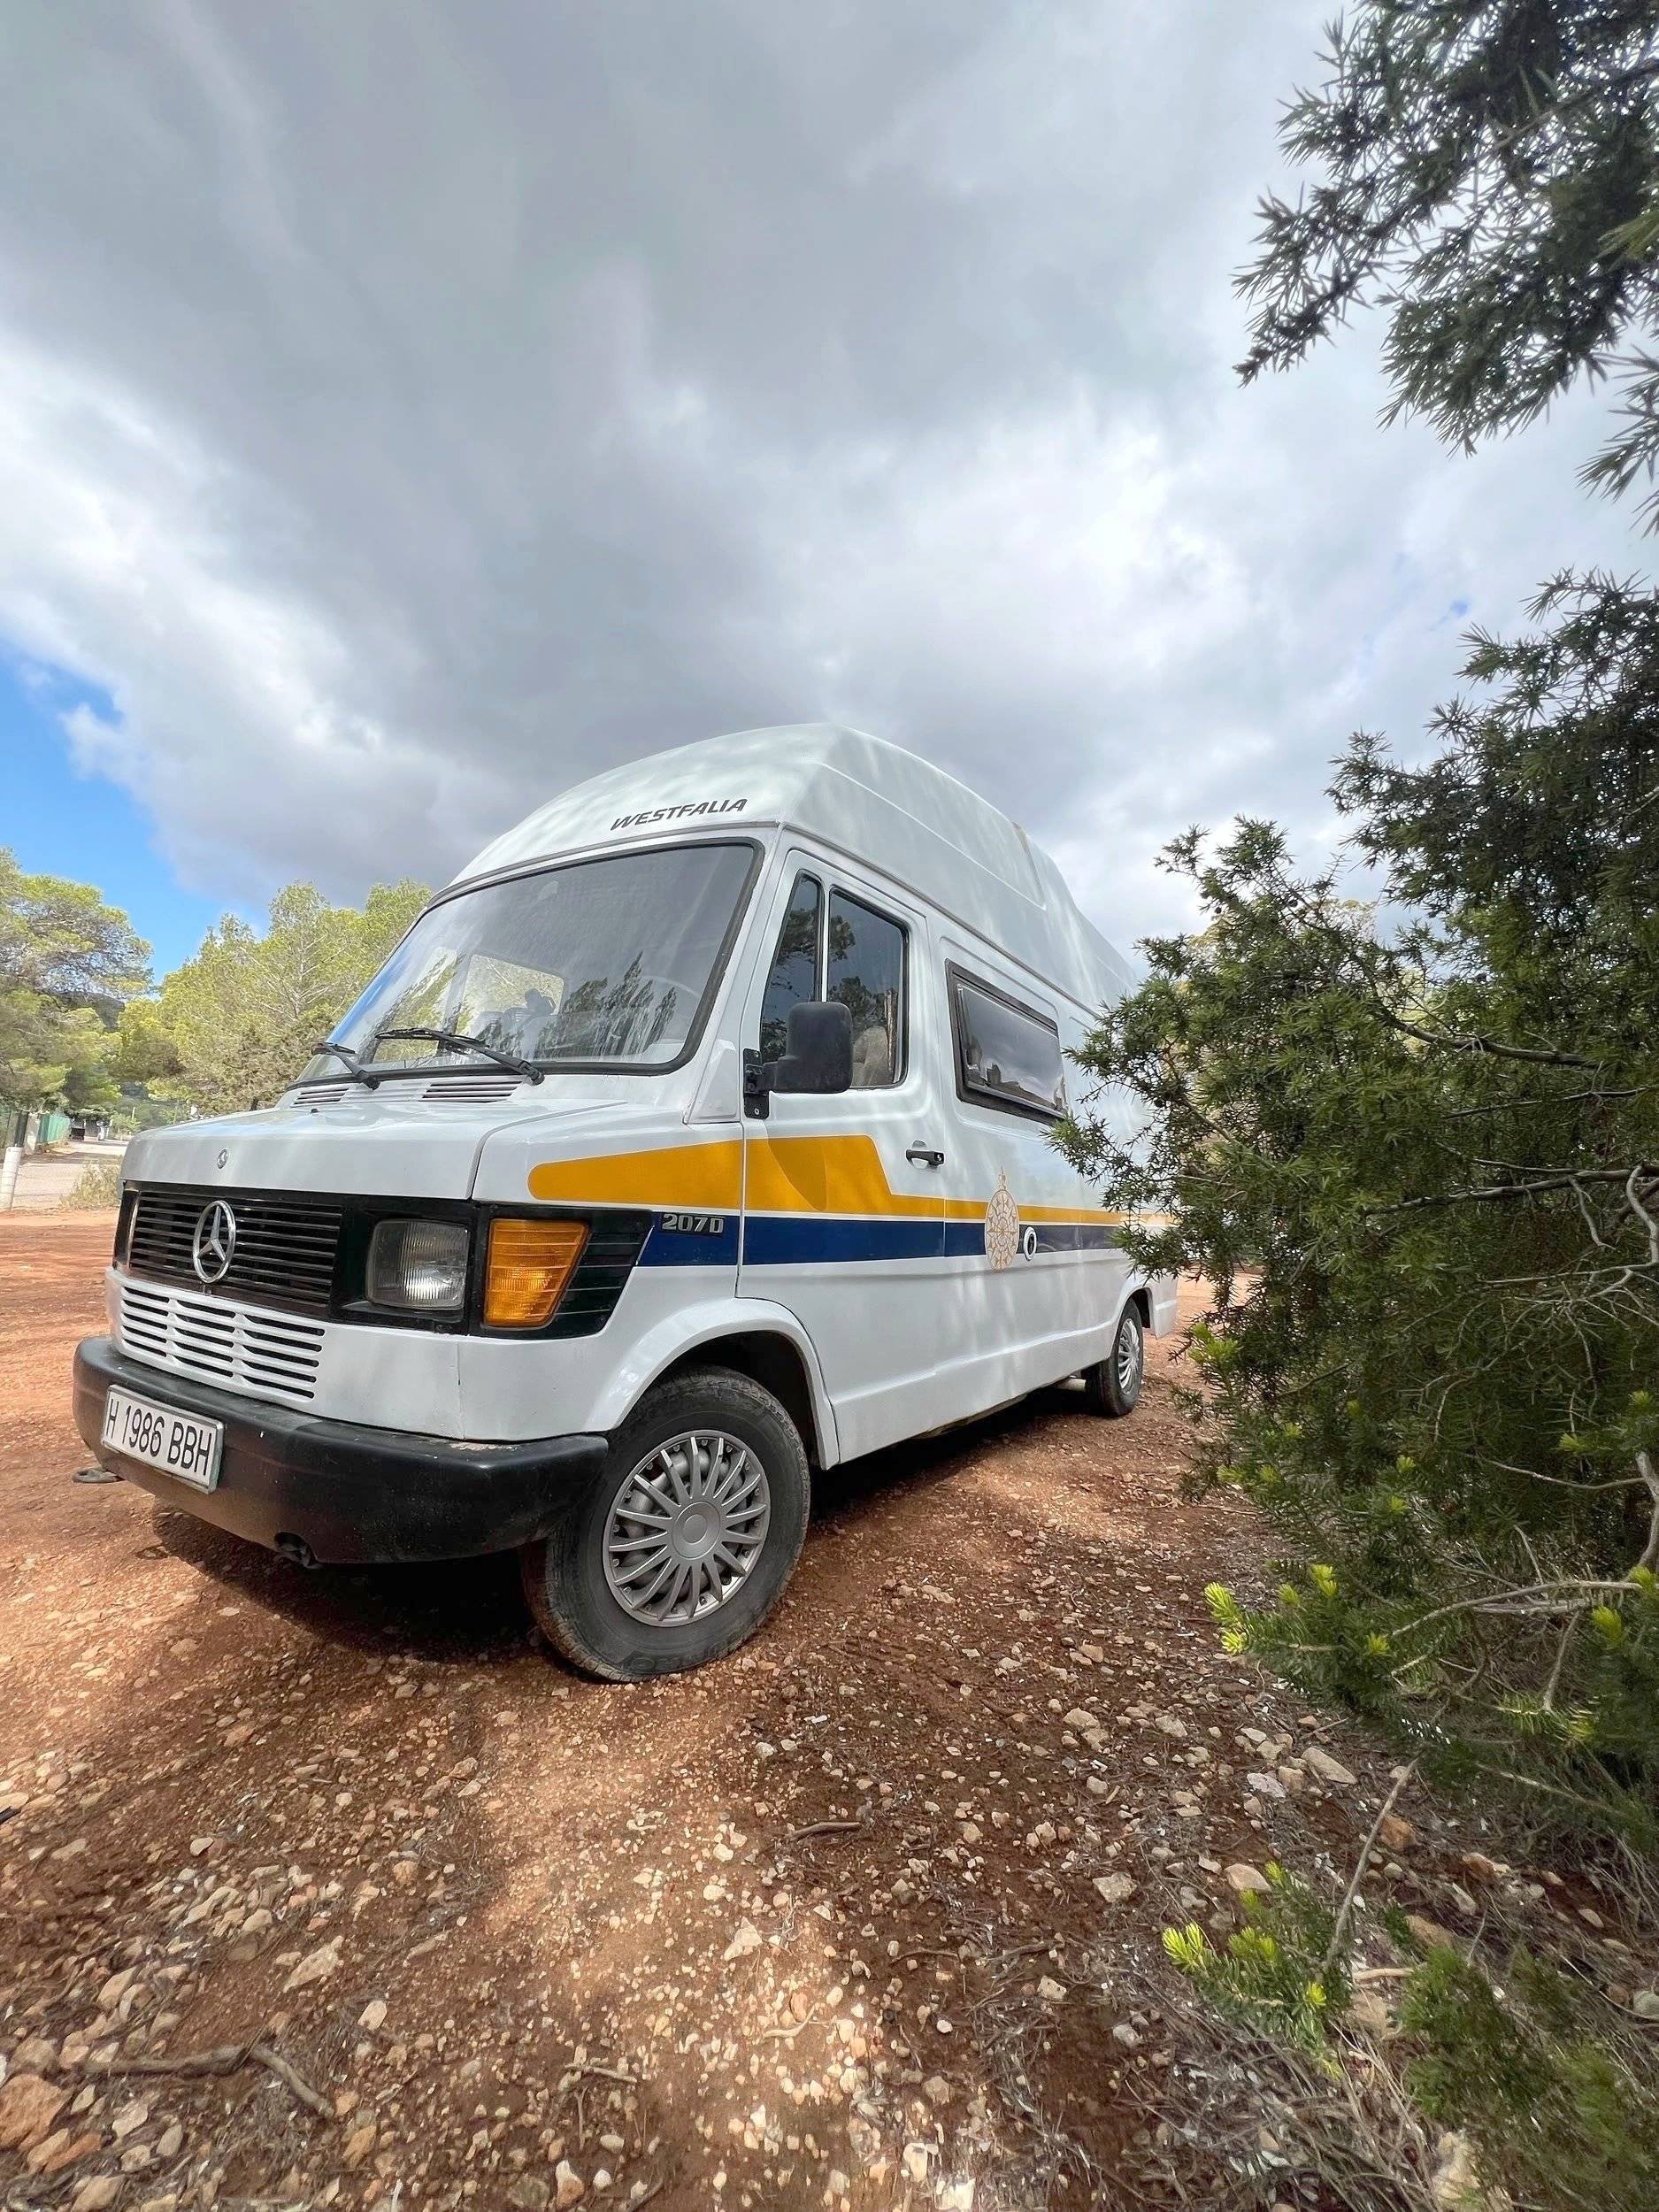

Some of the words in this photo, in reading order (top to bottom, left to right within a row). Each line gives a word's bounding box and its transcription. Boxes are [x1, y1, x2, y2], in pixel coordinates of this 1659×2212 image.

[611, 798, 748, 831] WESTFALIA
[662, 1213, 725, 1233] 207D
[105, 1398, 119, 1439] H
[122, 1405, 165, 1457] 1986
[167, 1421, 212, 1476] BBH
